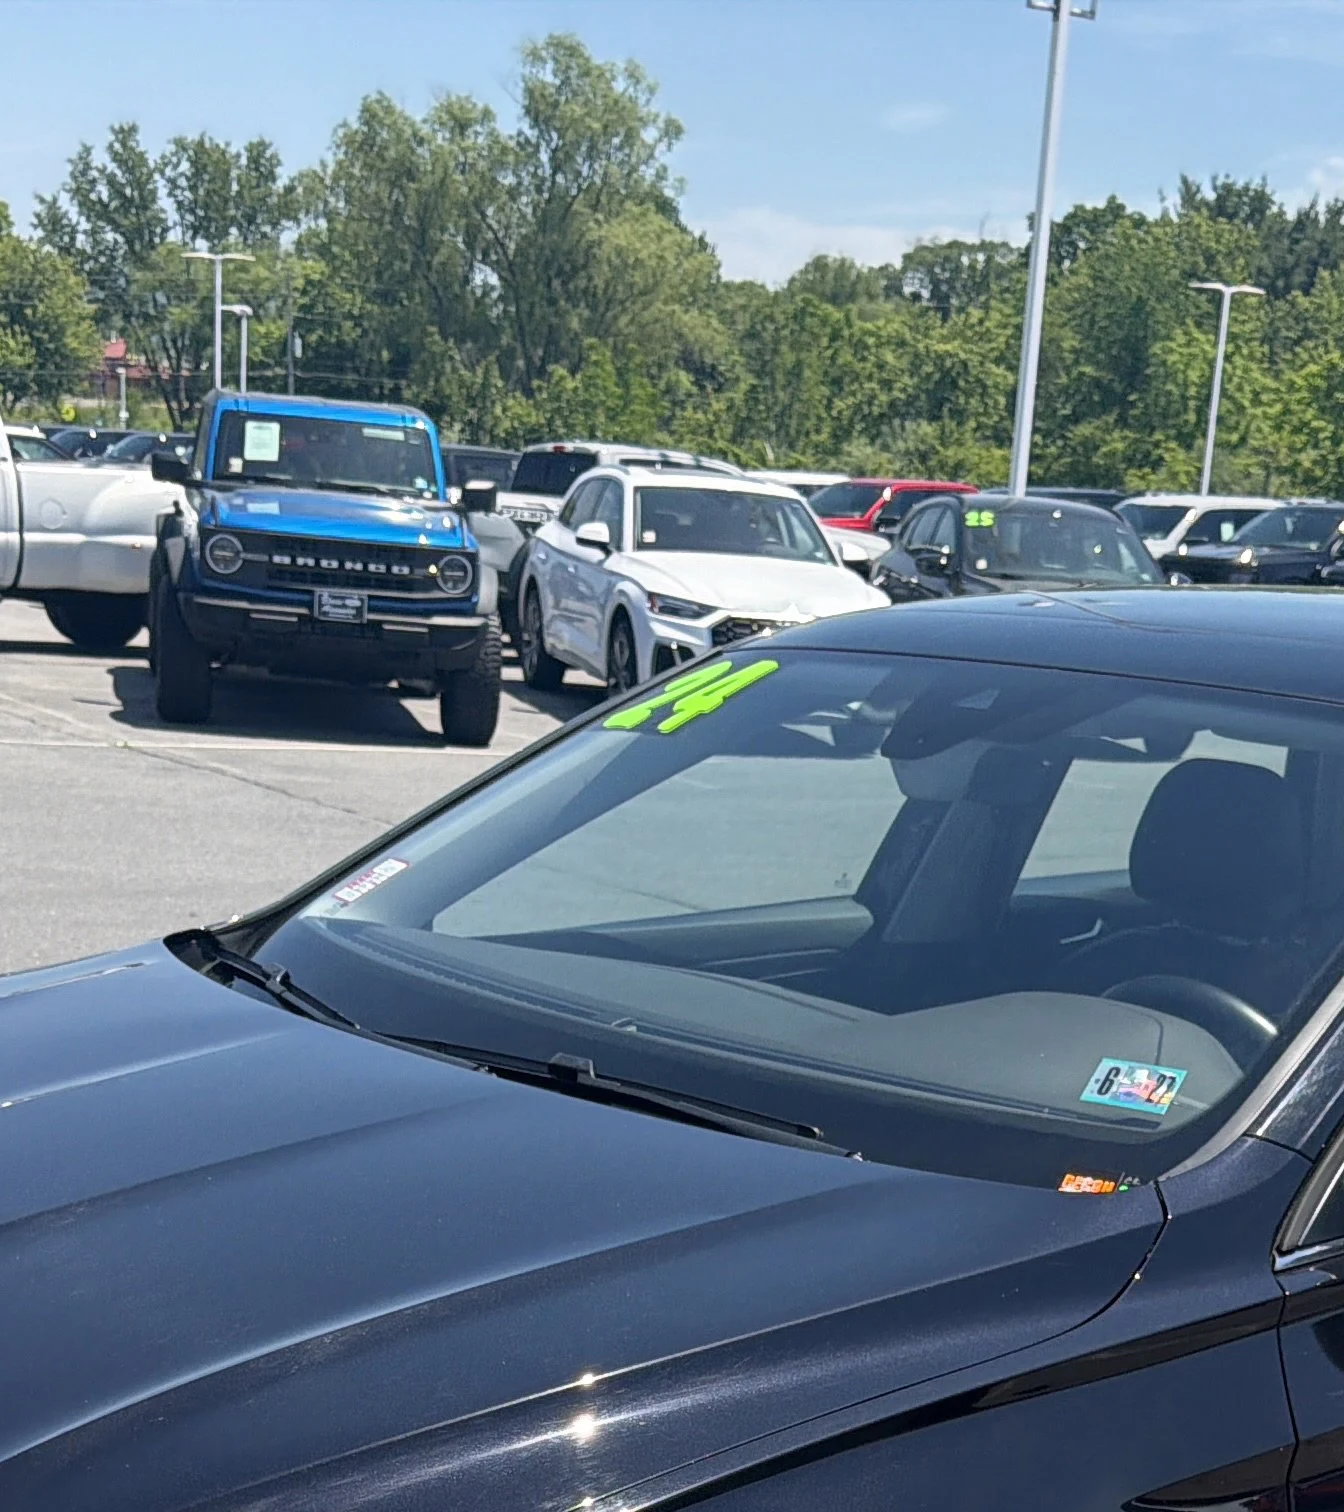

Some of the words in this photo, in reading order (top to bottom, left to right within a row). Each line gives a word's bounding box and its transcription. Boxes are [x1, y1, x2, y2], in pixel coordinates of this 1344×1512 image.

[964, 510, 995, 527] 25
[271, 554, 410, 575] BRONCO
[602, 659, 780, 735] 24
[1096, 1066, 1121, 1095] 6
